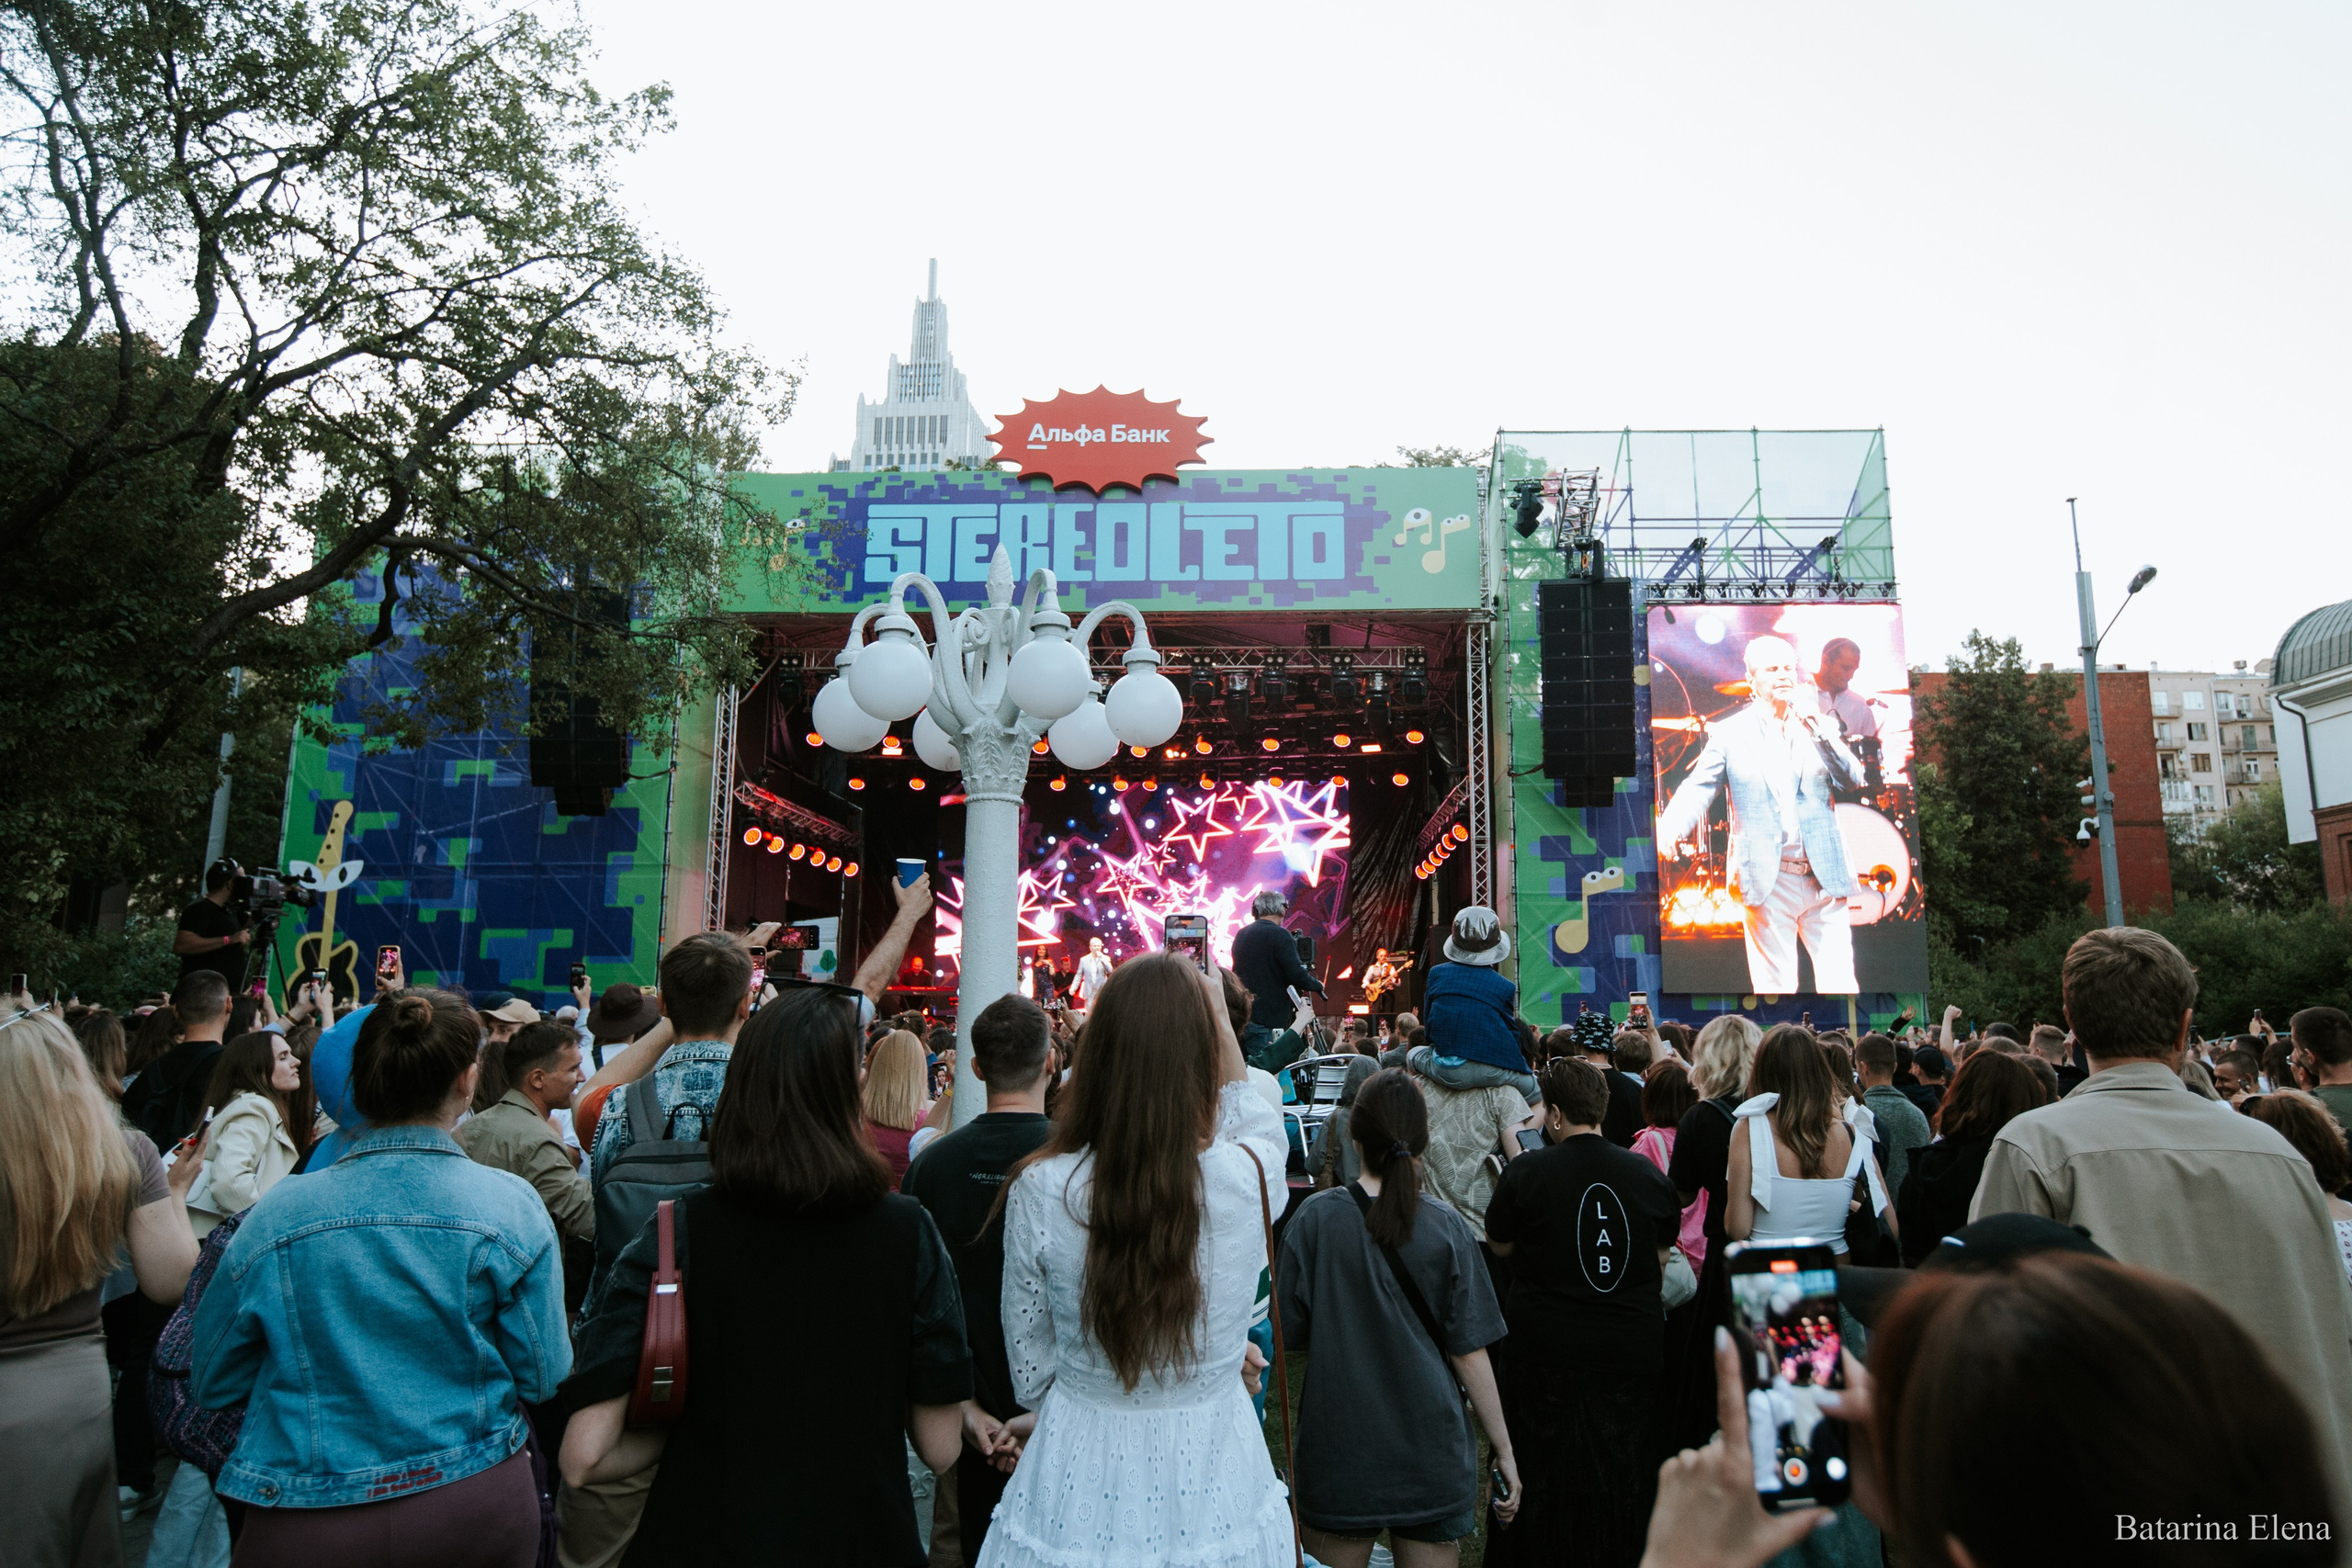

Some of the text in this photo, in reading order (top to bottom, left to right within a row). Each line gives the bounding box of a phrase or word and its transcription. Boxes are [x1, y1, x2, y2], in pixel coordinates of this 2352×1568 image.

[1027, 423, 1170, 447] Альфа Банк
[865, 502, 1345, 582] STEREOLETO
